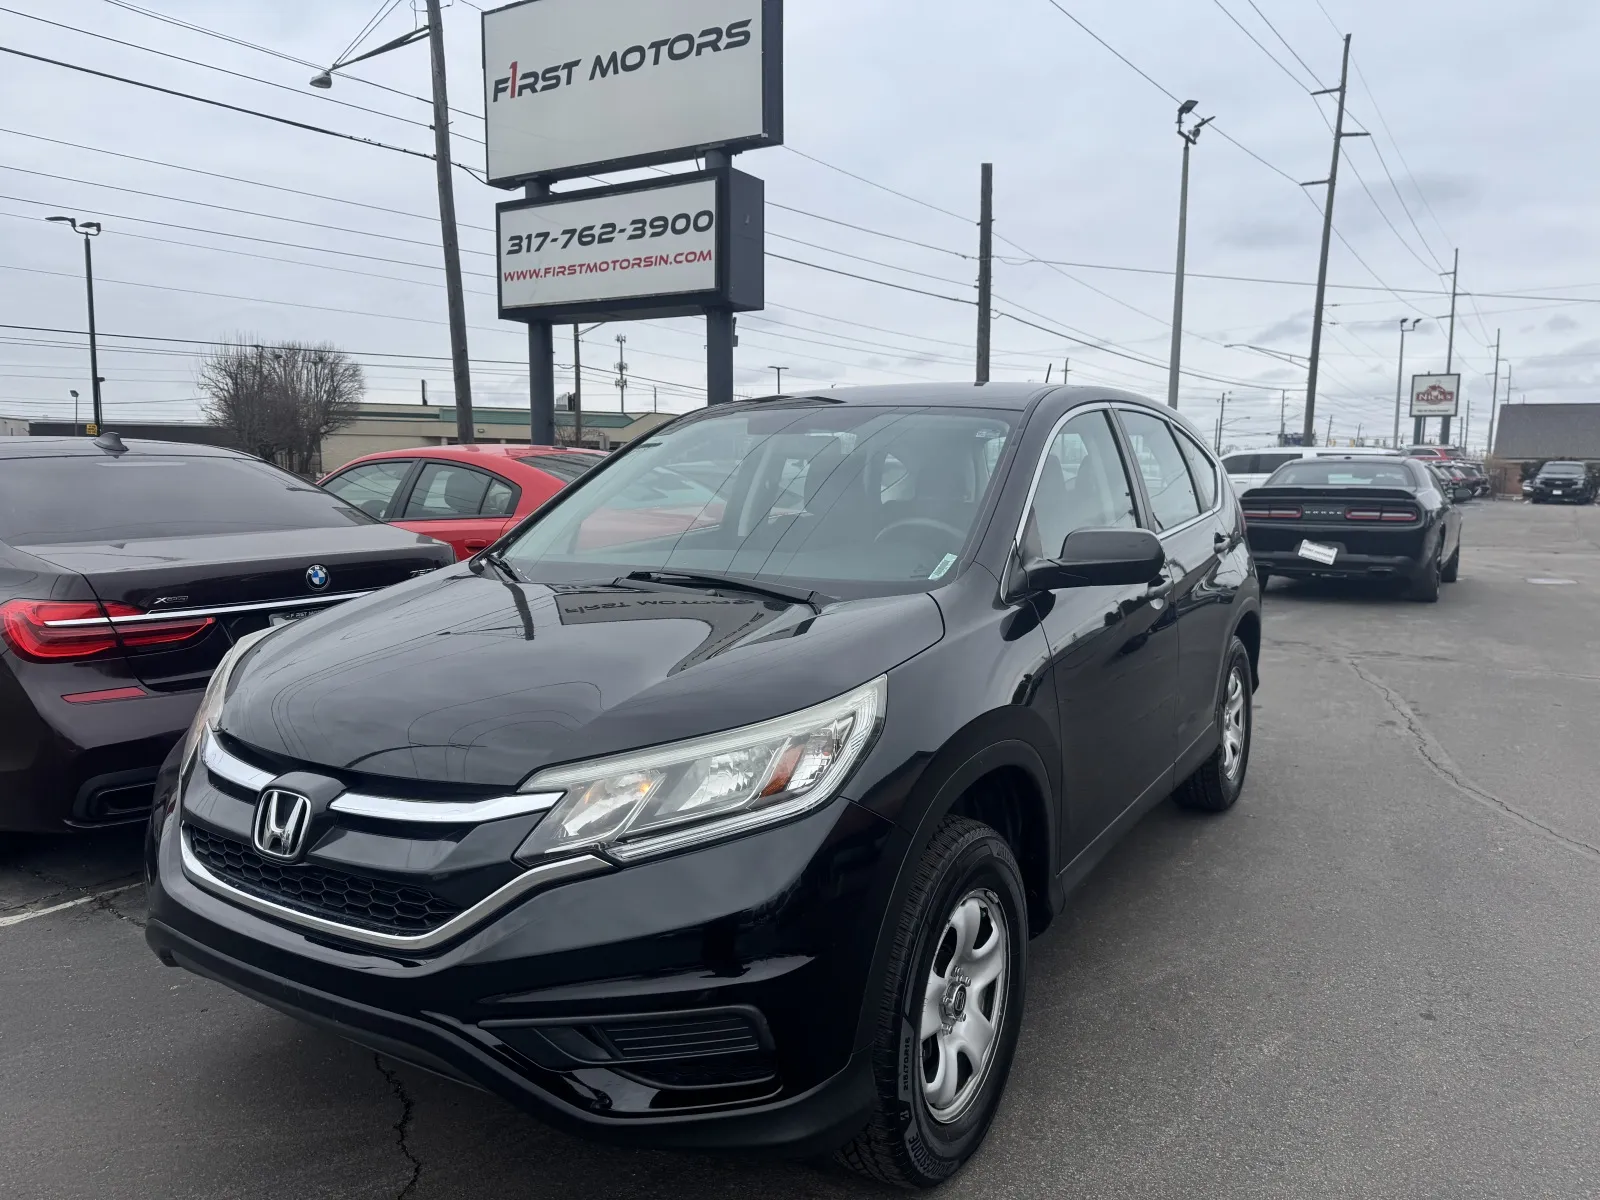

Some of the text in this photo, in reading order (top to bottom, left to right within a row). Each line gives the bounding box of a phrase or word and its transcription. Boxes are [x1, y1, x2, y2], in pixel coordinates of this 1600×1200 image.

[588, 18, 752, 81] MOTORS
[506, 209, 714, 255] 317-762-3900
[503, 249, 712, 282] WWW.FIRSTMOTORSIN.COM
